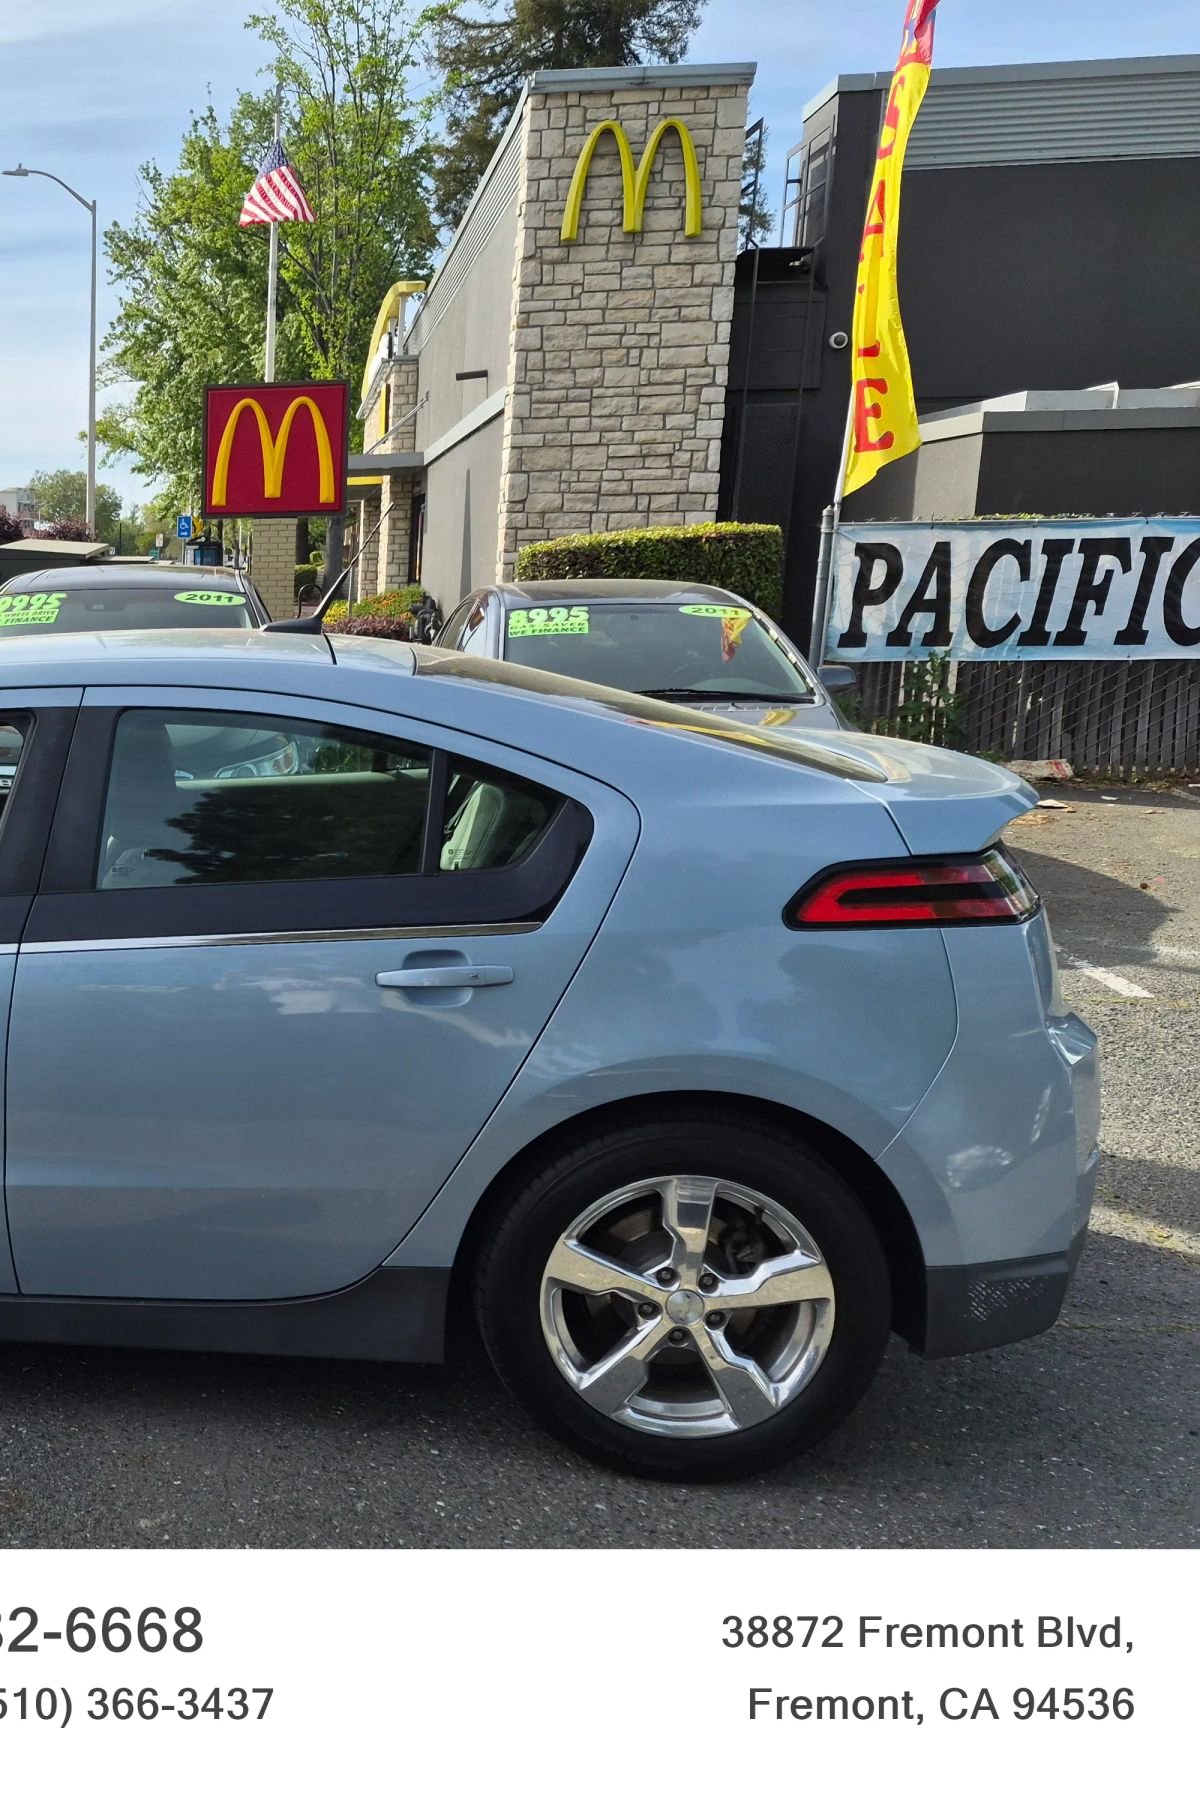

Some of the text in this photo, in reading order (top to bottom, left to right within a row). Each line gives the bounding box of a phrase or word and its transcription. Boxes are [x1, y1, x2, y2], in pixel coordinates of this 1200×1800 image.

[837, 536, 1200, 648] PACIFIC
[185, 593, 234, 603] 2011
[508, 606, 589, 625] 8995
[691, 607, 739, 616] 2011
[4, 615, 53, 624] FINANCE
[531, 626, 585, 634] FINANCE
